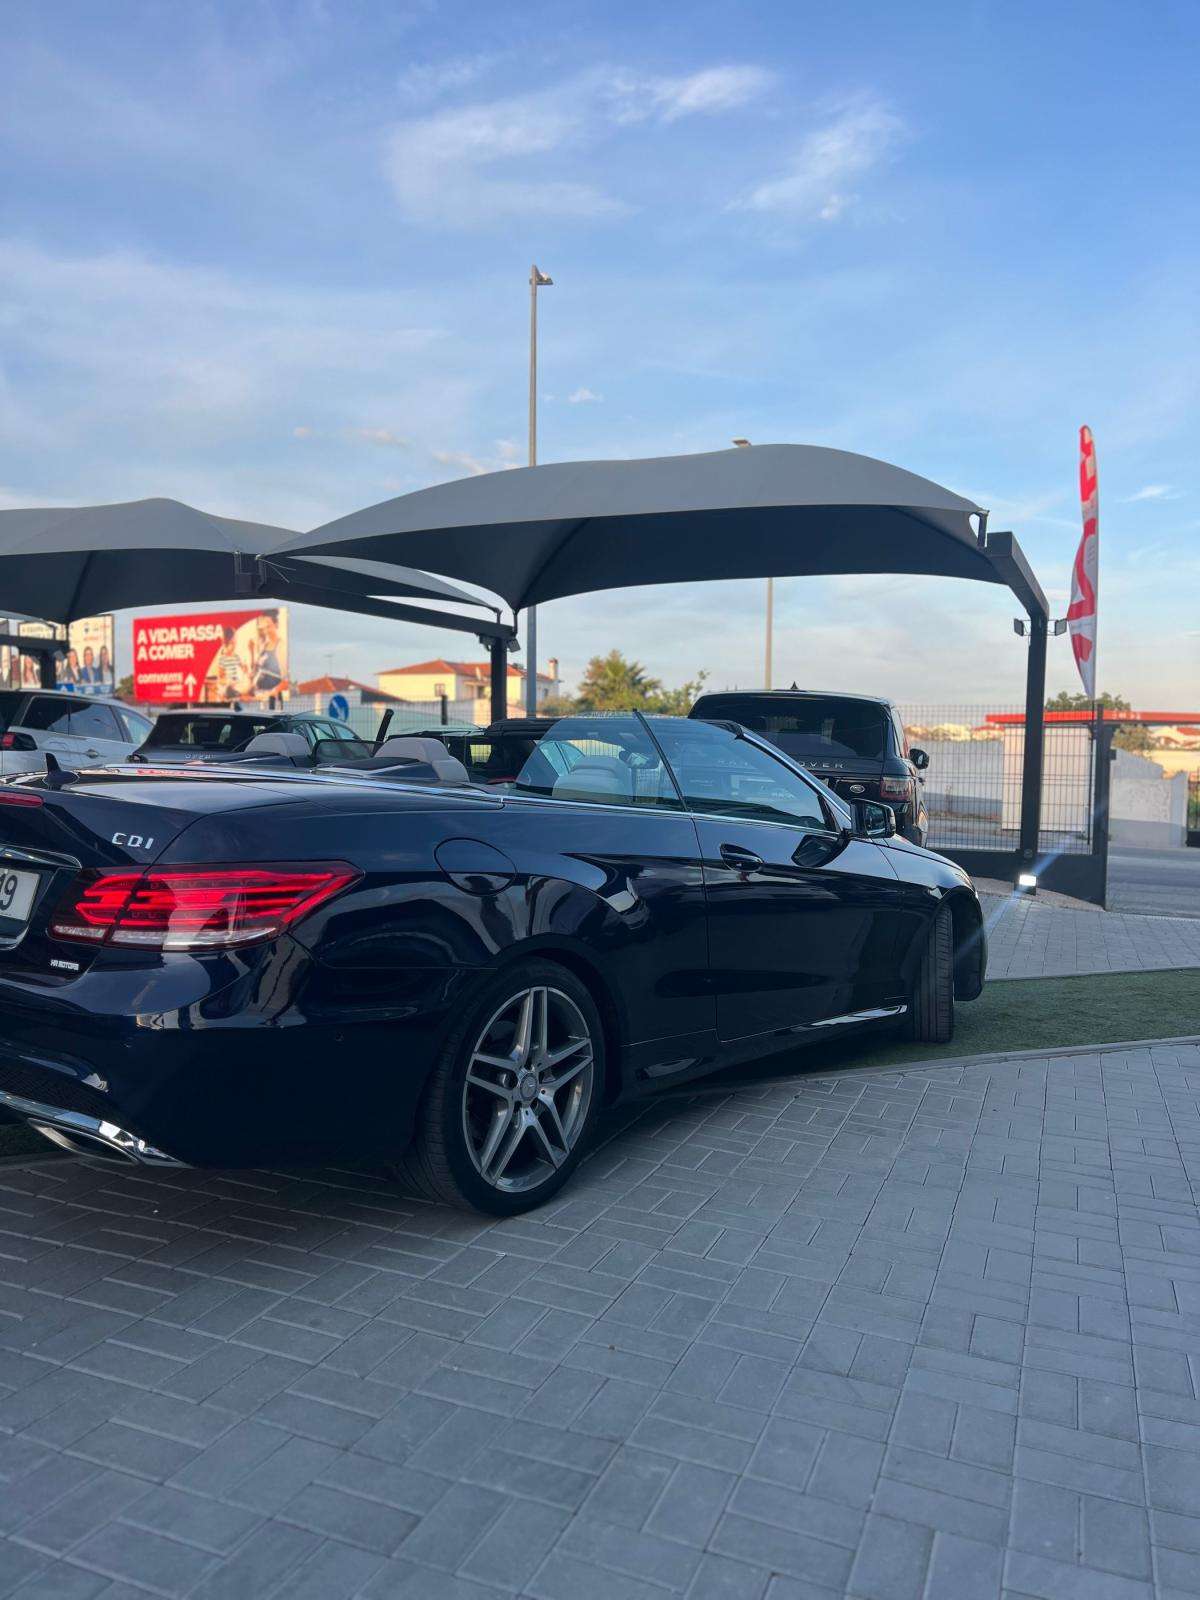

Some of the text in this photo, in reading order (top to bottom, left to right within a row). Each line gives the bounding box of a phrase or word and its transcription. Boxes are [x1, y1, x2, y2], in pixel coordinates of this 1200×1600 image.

[137, 624, 223, 644] A VIDA PASSA
[137, 643, 194, 661] A COMER
[800, 761, 843, 769] OVER
[112, 832, 154, 849] CDI
